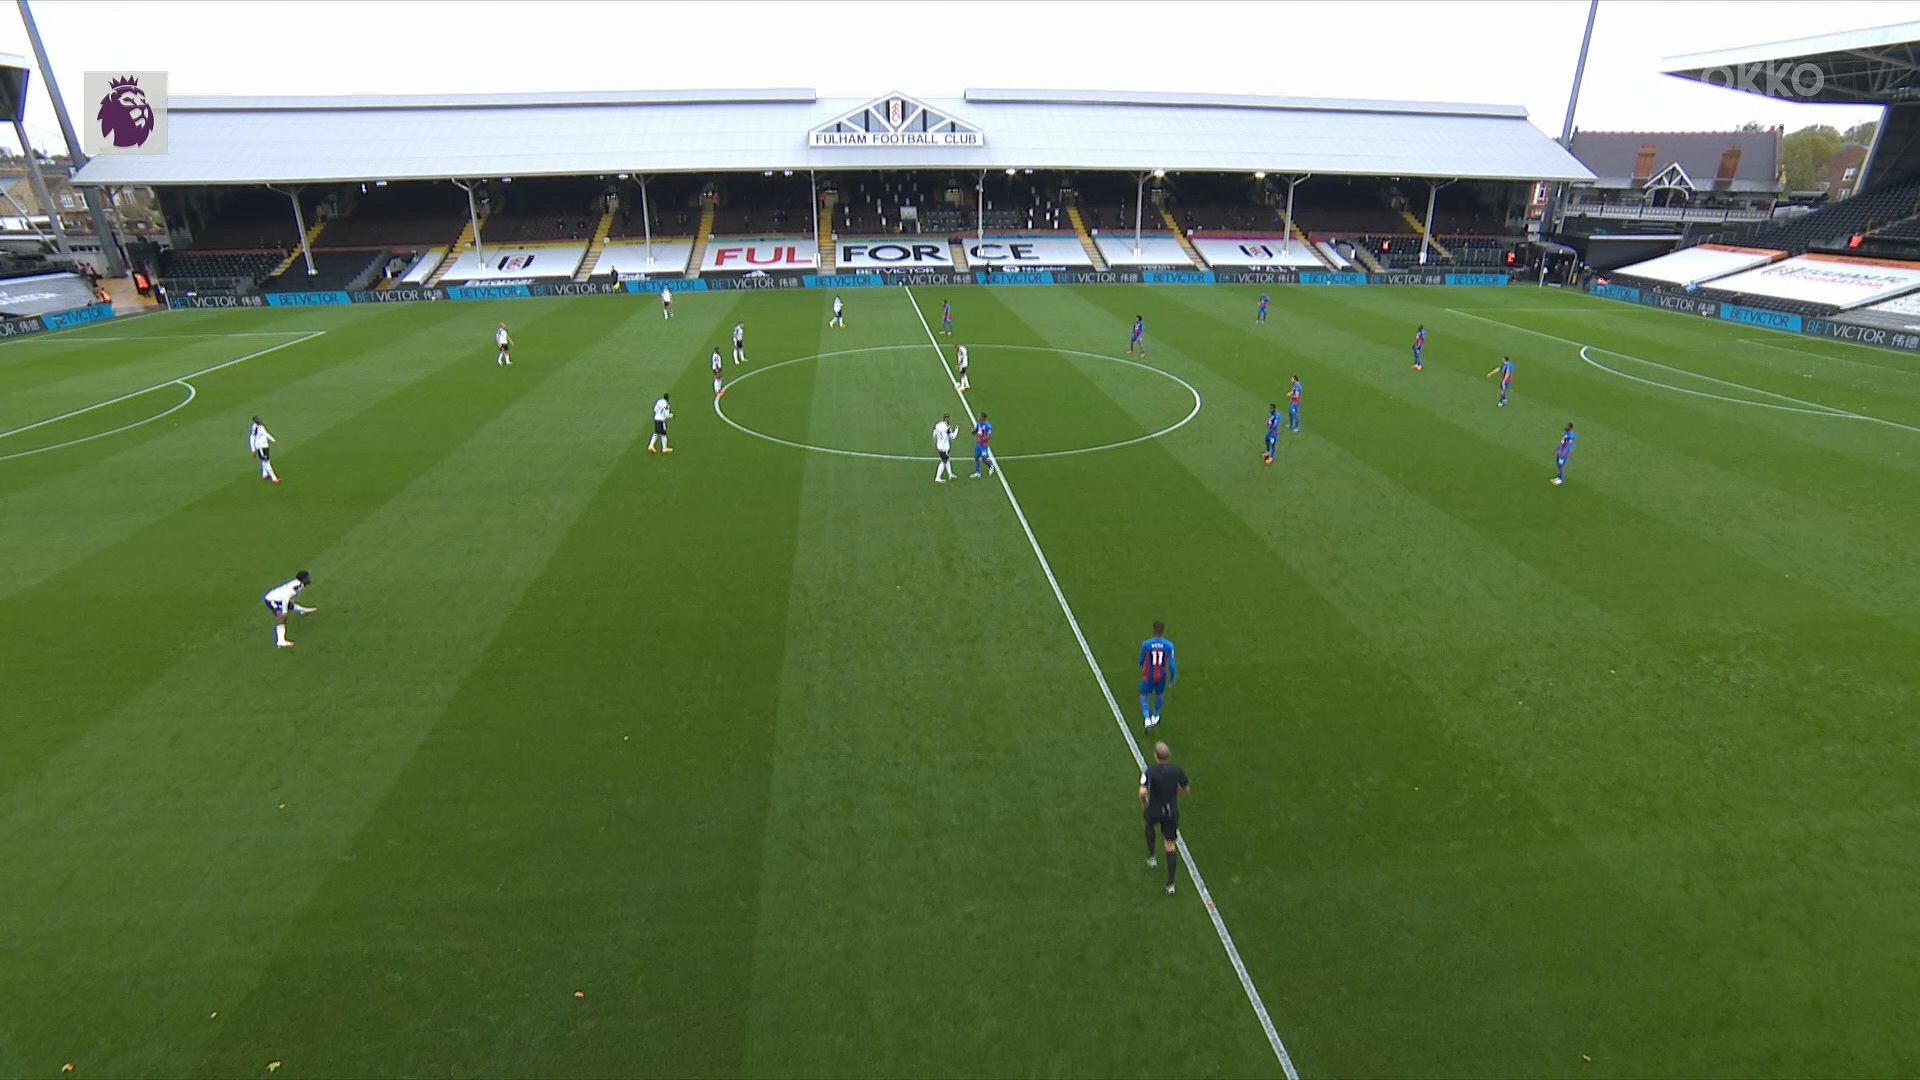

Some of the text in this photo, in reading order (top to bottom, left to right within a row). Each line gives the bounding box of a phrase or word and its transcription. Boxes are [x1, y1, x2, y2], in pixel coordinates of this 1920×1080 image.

[816, 133, 977, 145] FULHAM FOOTBALL CLUB
[715, 243, 1040, 266] FUL FOR CE
[711, 277, 775, 290] BETVICTOR
[814, 275, 871, 287] BETVICTOR
[1057, 272, 1116, 284] BETVICTOR
[1153, 271, 1206, 283] BETVICTOR
[1218, 272, 1275, 284] BETVICTOR
[1370, 273, 1422, 285] BETVICTOR
[533, 283, 597, 296] BETVICTOR
[638, 279, 696, 292] BETVICTOR
[279, 292, 338, 305] BETVICTOR
[354, 289, 420, 302] BETVICTOR
[460, 286, 517, 299] BETVICTOR
[171, 295, 238, 308] BETVICTOR
[1643, 292, 1695, 313] BETVICTOR
[1729, 305, 1790, 328] BETVICTOR
[1806, 319, 1886, 345] BETVICTOR
[1150, 650, 1164, 667] 11
